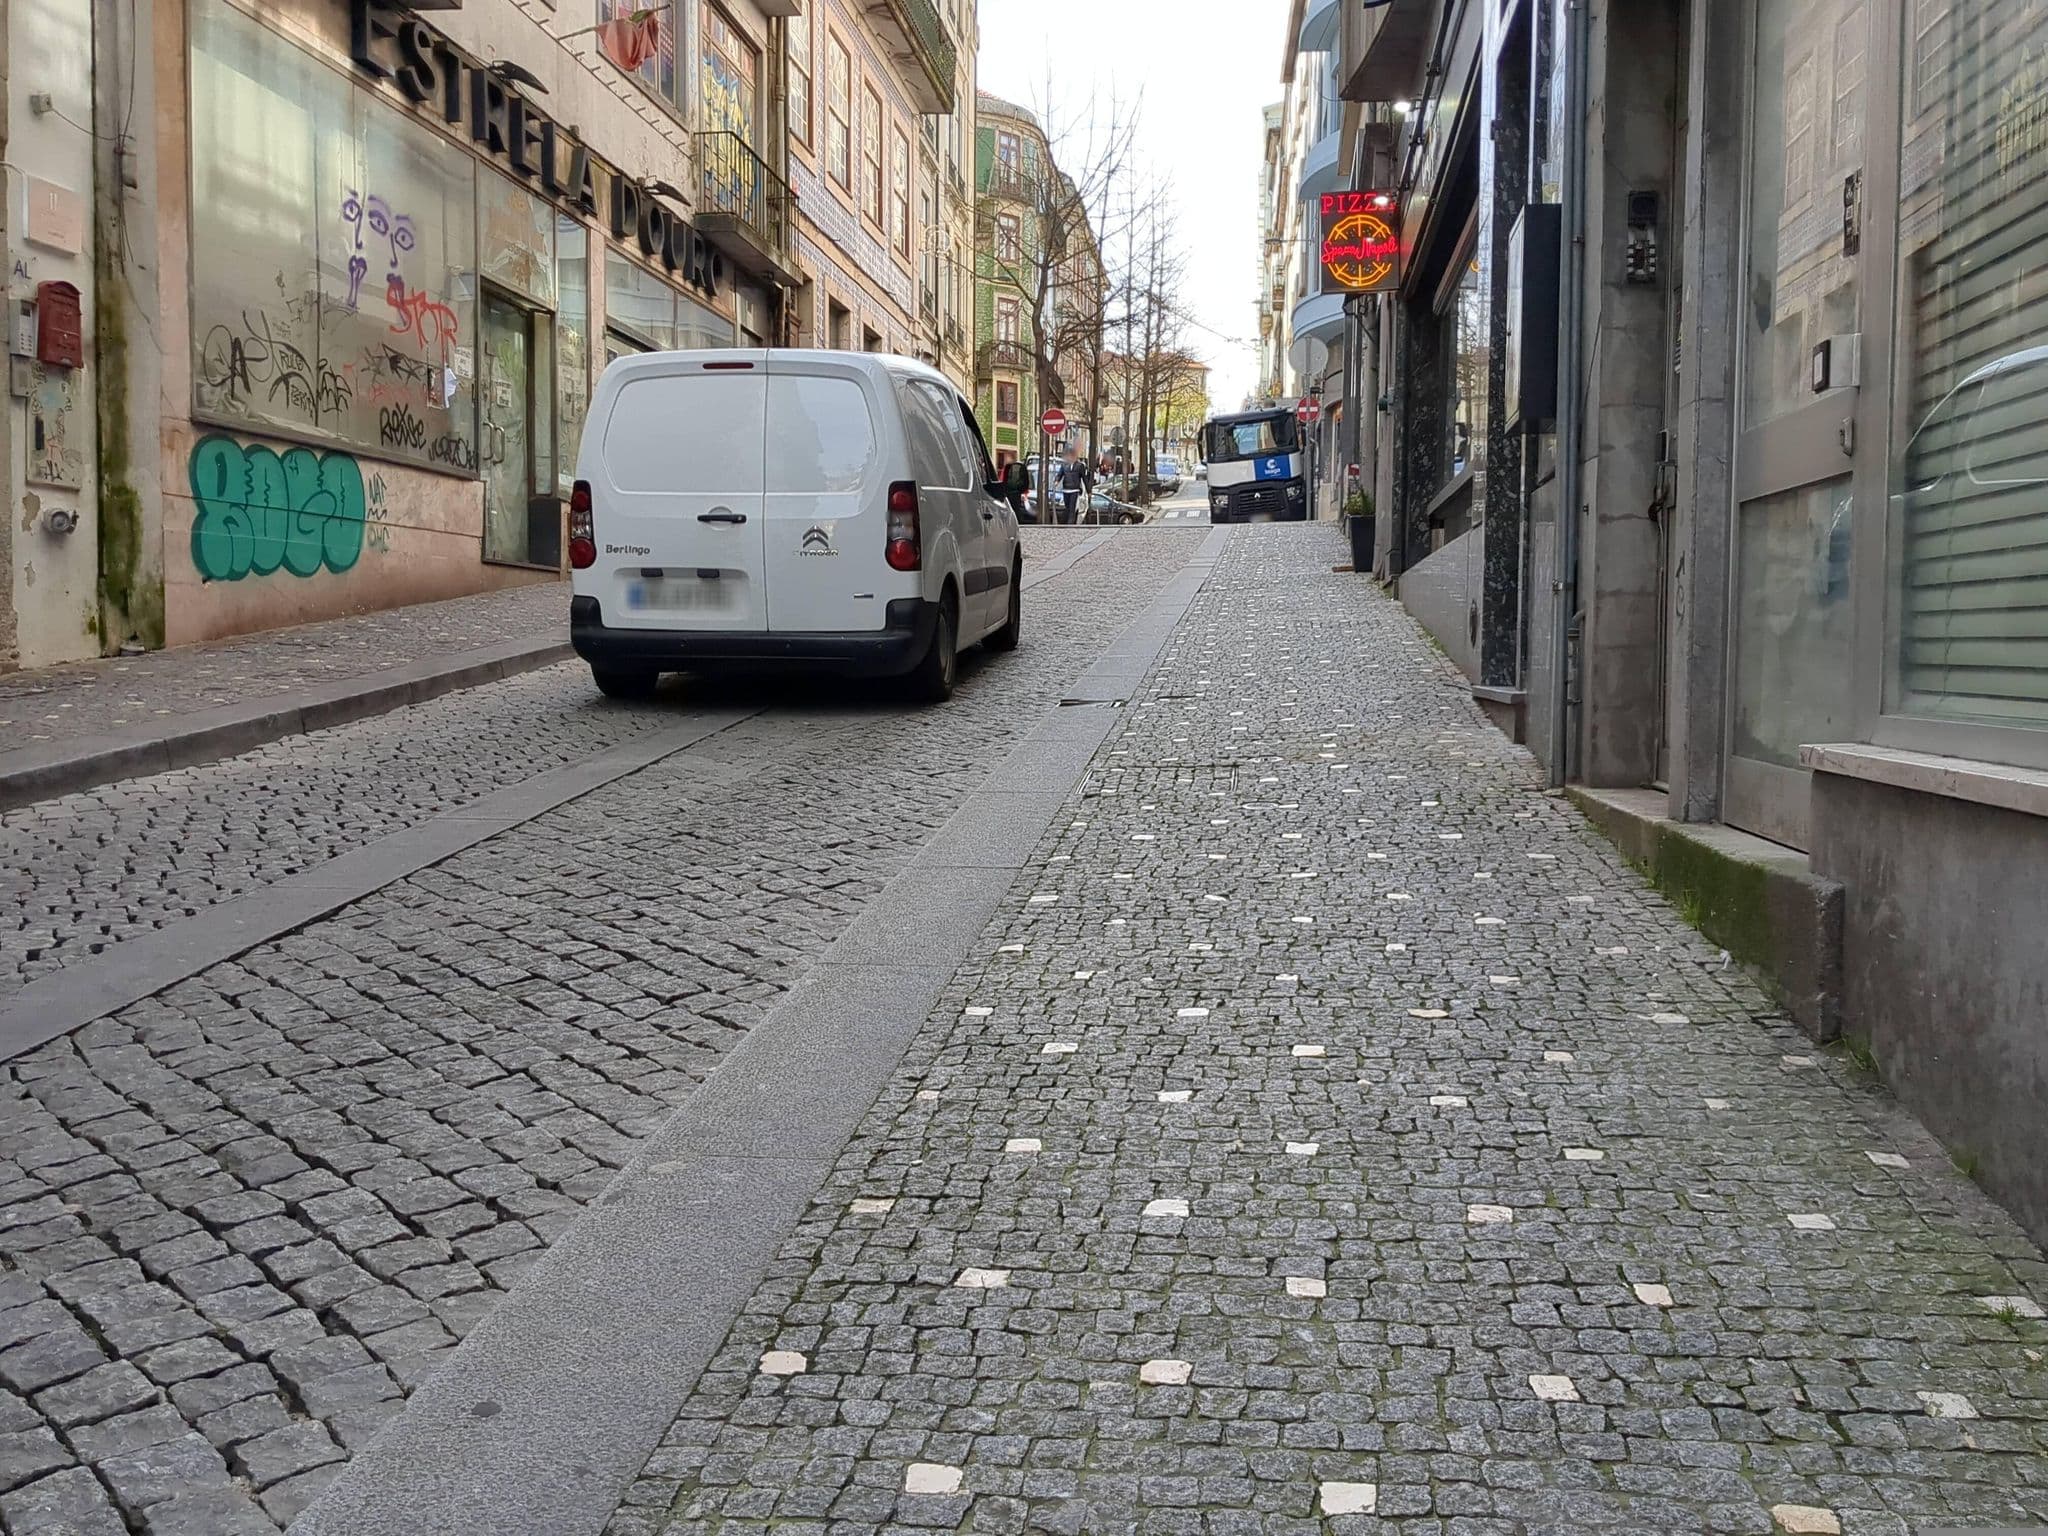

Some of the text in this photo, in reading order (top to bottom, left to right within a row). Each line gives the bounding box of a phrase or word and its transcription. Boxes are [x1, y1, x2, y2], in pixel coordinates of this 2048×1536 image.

[351, 0, 598, 218] ESTRELA
[14, 259, 32, 280] AL
[605, 543, 651, 556] Berlingo
